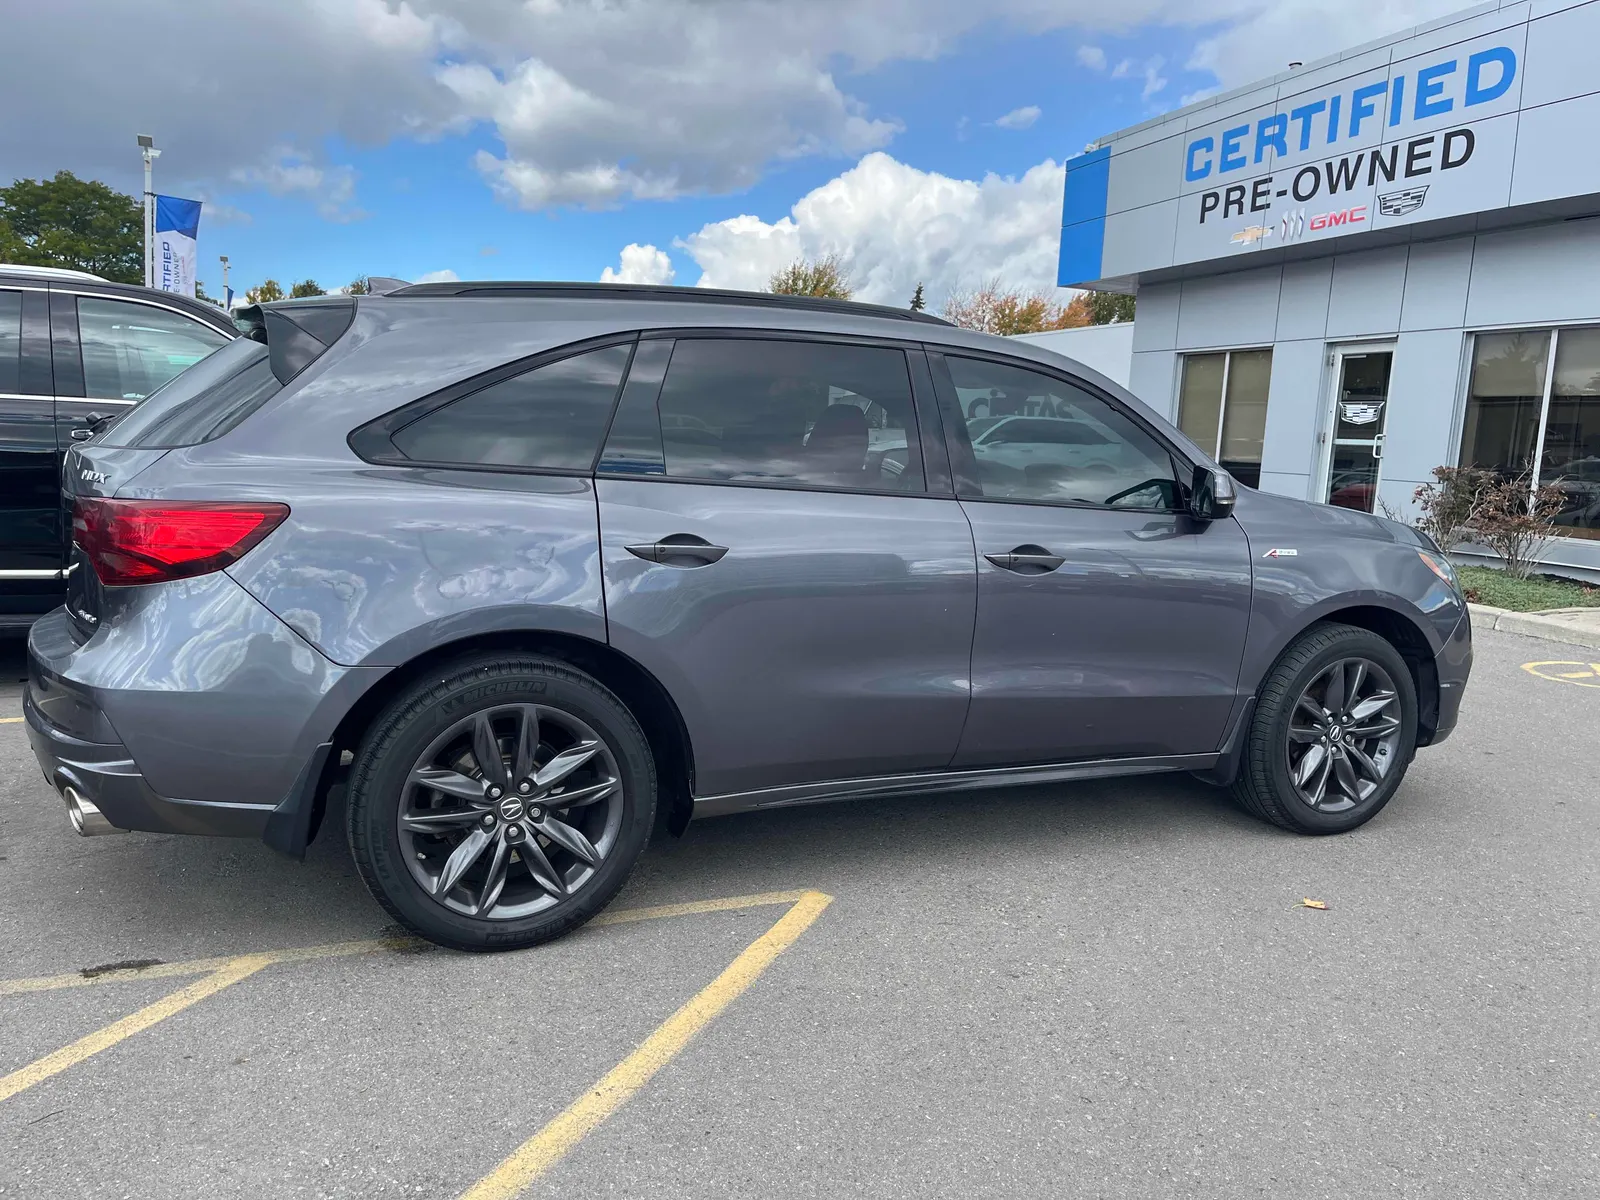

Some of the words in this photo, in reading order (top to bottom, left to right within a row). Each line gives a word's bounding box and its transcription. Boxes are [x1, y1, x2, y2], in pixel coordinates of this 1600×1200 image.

[1185, 46, 1517, 183] CERTIFIED
[1199, 128, 1476, 224] PRE-OWNED
[1309, 206, 1367, 231] GMC
